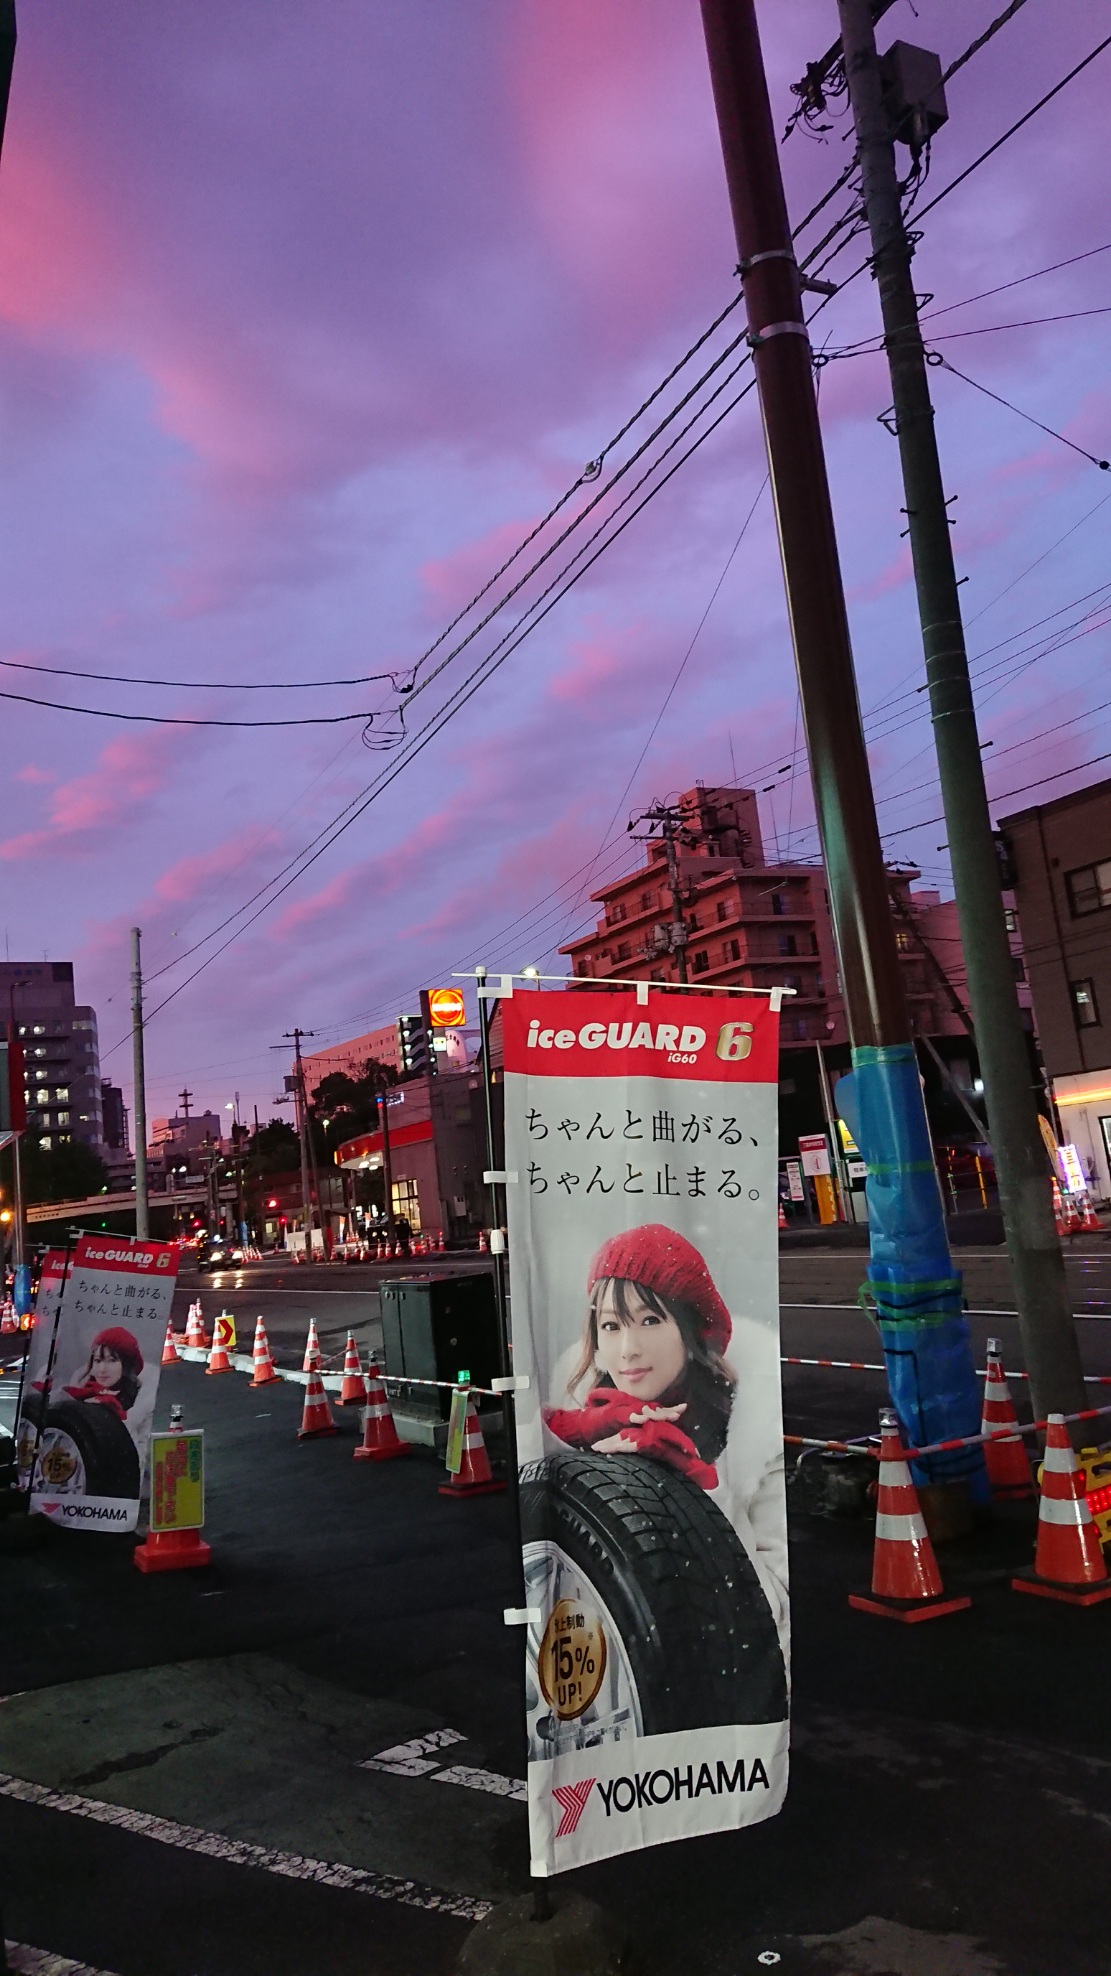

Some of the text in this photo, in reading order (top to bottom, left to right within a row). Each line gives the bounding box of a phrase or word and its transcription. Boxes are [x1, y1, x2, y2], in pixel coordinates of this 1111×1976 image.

[527, 1019, 754, 1061] iceGUARD 6
[667, 1052, 697, 1064] iG60
[525, 1108, 758, 1147] ちゃんと曲がる、
[526, 1161, 760, 1201] ちゃんと止まる。
[85, 1246, 171, 1268] iceGUARD 6
[79, 1280, 166, 1301] ちゃんと曲がる、
[62, 1504, 128, 1521] YOKOHAMA
[551, 1636, 595, 1682] 15%
[558, 1681, 583, 1706] UP!
[596, 1757, 770, 1817] YOKOHAMA
